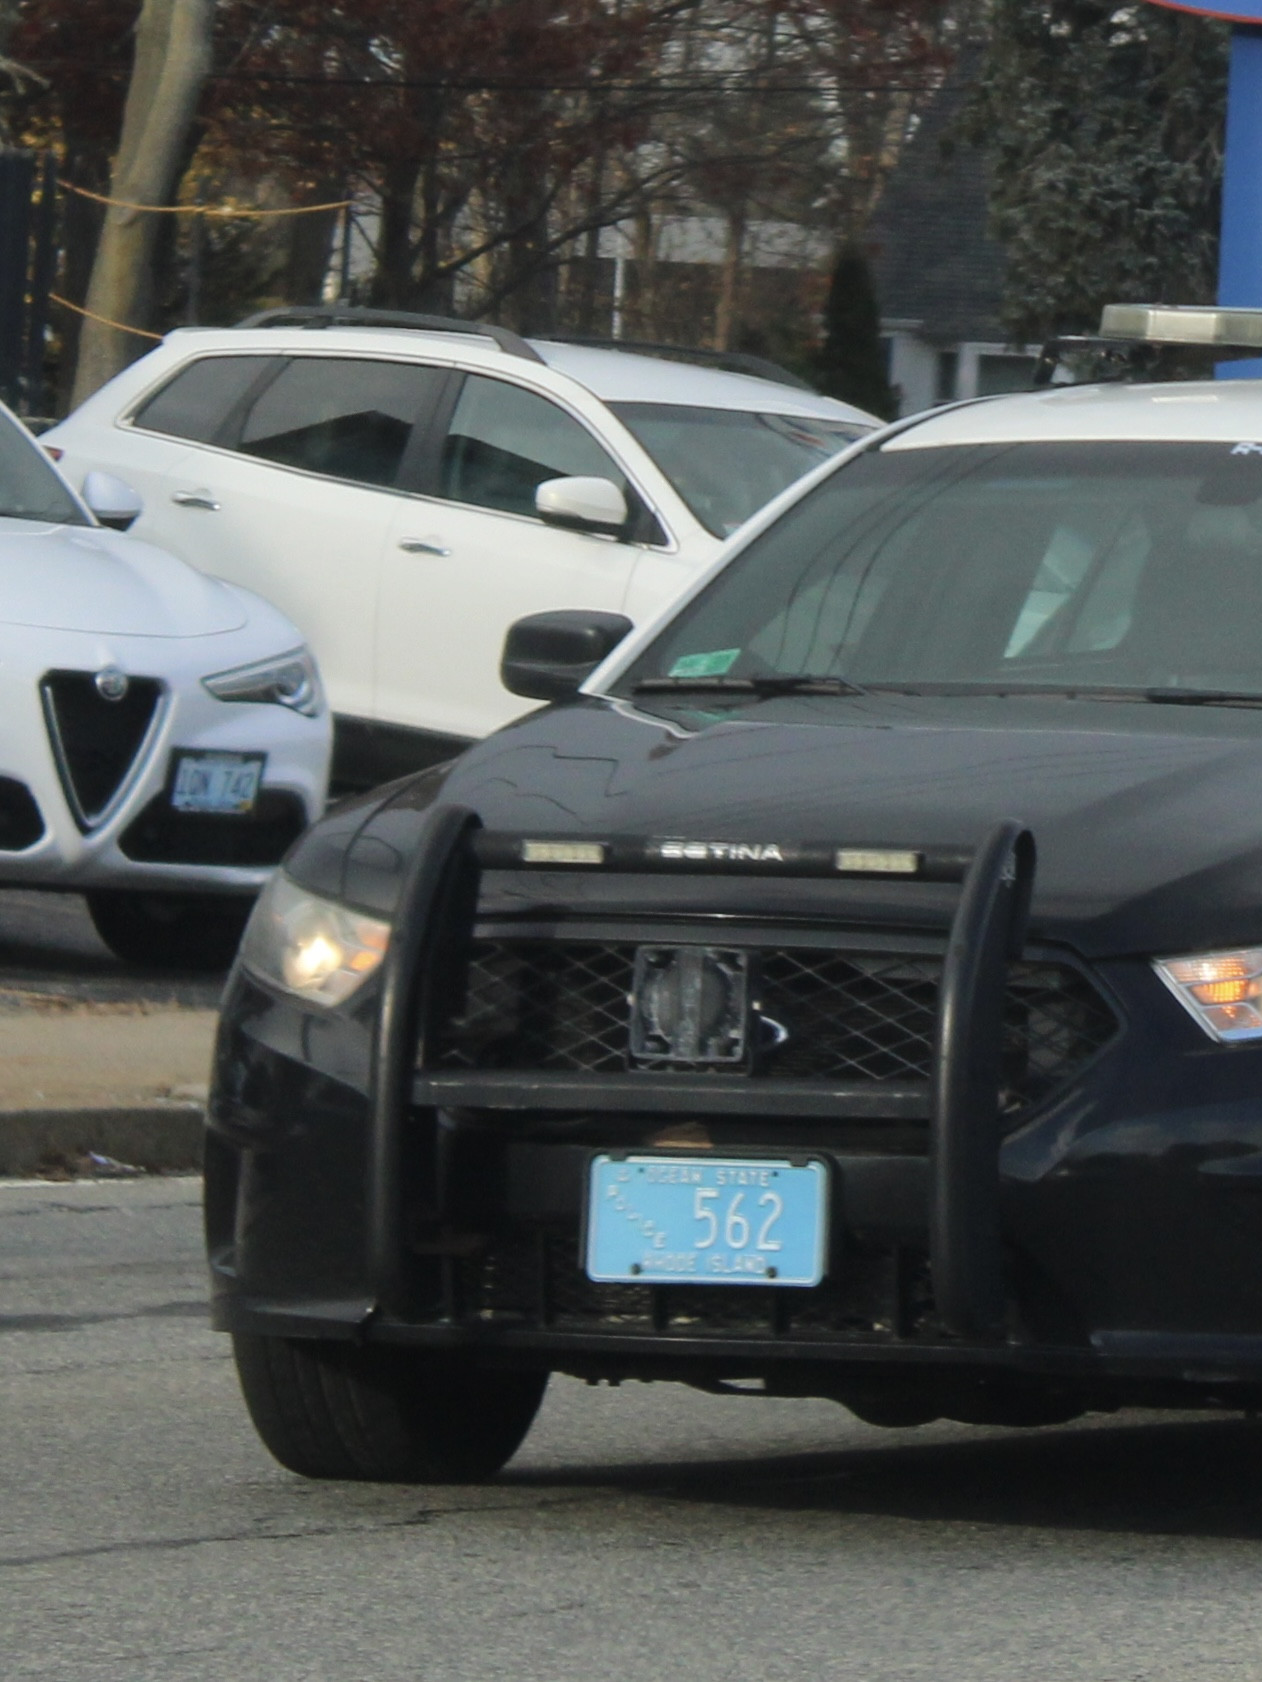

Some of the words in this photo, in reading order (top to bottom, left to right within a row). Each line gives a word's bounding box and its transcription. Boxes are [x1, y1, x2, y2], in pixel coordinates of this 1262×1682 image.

[660, 840, 784, 861] SETINA
[647, 1166, 703, 1184] OCEAN
[716, 1169, 770, 1187] STATE
[694, 1187, 783, 1251] 562
